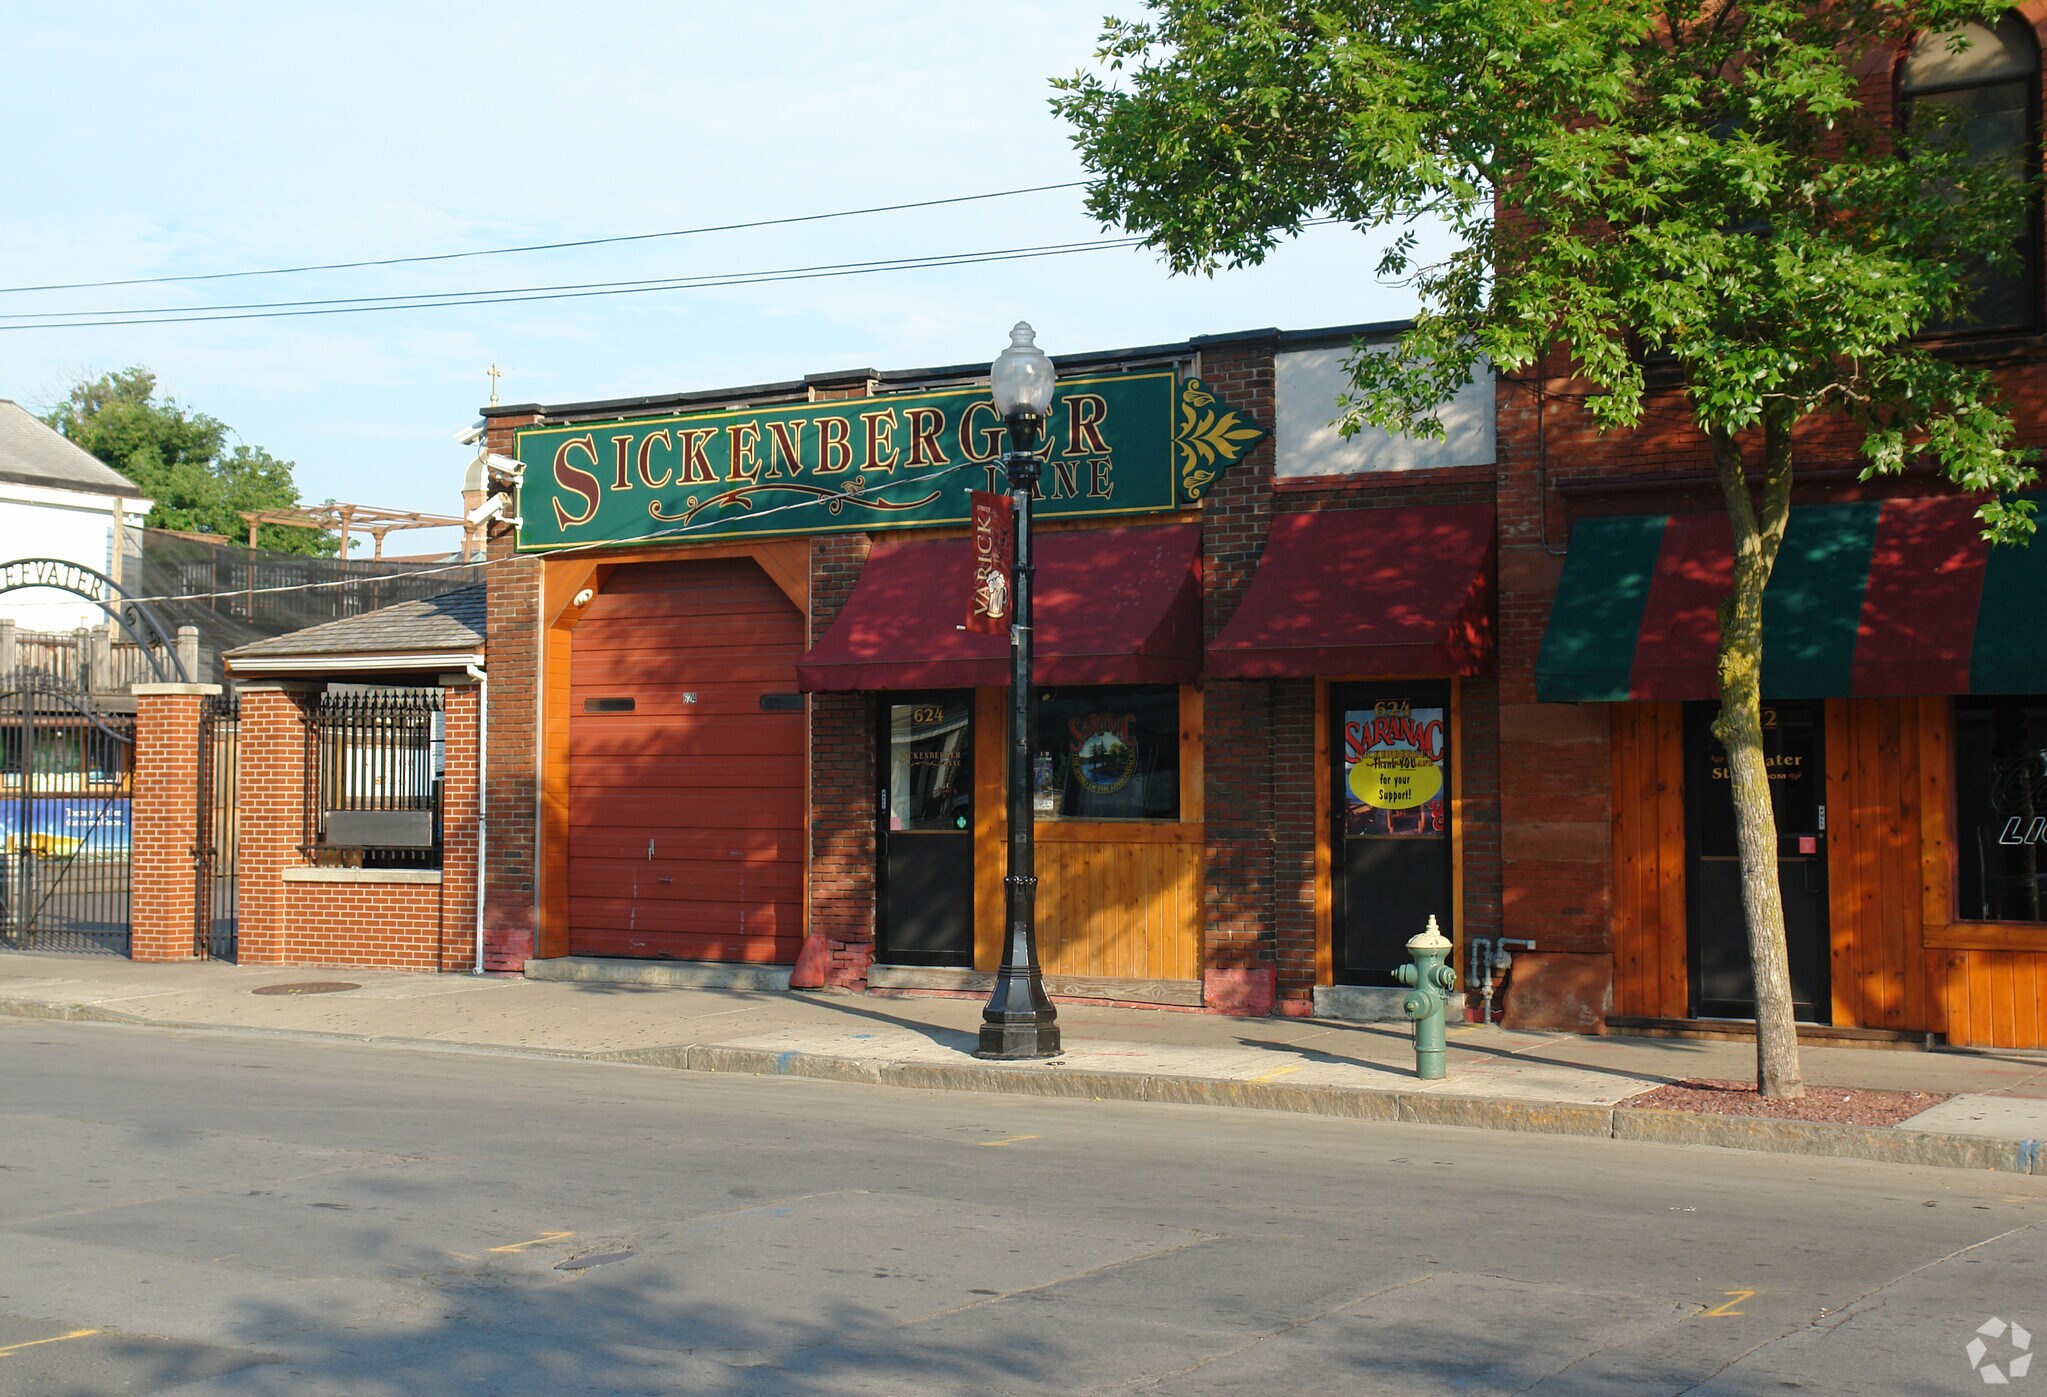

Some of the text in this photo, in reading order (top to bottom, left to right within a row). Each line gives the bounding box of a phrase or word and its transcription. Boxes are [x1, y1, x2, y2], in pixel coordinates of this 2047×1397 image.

[974, 515, 993, 617] VARICK
[914, 706, 944, 724] 624
[1373, 700, 1411, 717] 624
[1345, 716, 1444, 764] SARANAC
[1374, 757, 1416, 769] Thank YOU
[1380, 773, 1411, 787] for your
[1379, 788, 1411, 803] Support!
